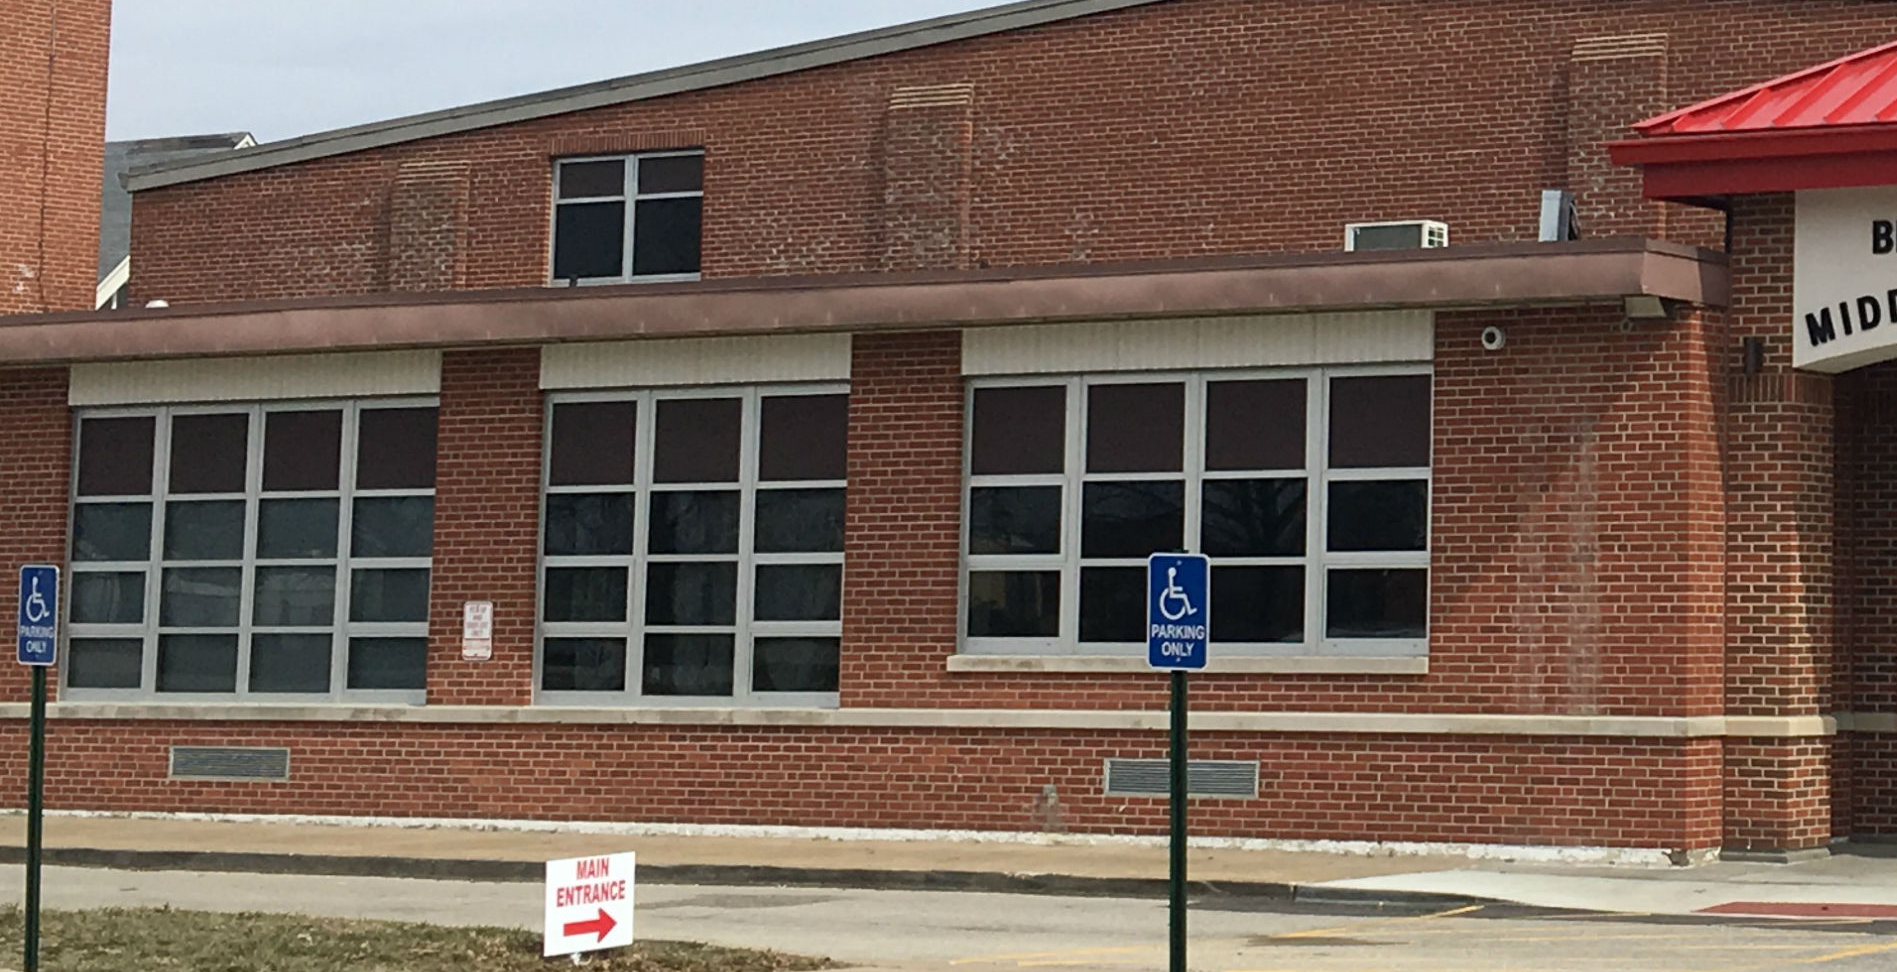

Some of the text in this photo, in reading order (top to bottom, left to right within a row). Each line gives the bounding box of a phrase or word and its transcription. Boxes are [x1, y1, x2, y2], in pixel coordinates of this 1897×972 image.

[20, 625, 54, 638] PARKING
[1151, 624, 1205, 640] PARKING
[26, 640, 47, 653] ONLY
[1161, 641, 1194, 657] ONLY
[576, 857, 609, 880] MAIN
[556, 880, 626, 907] ENTRANCE
